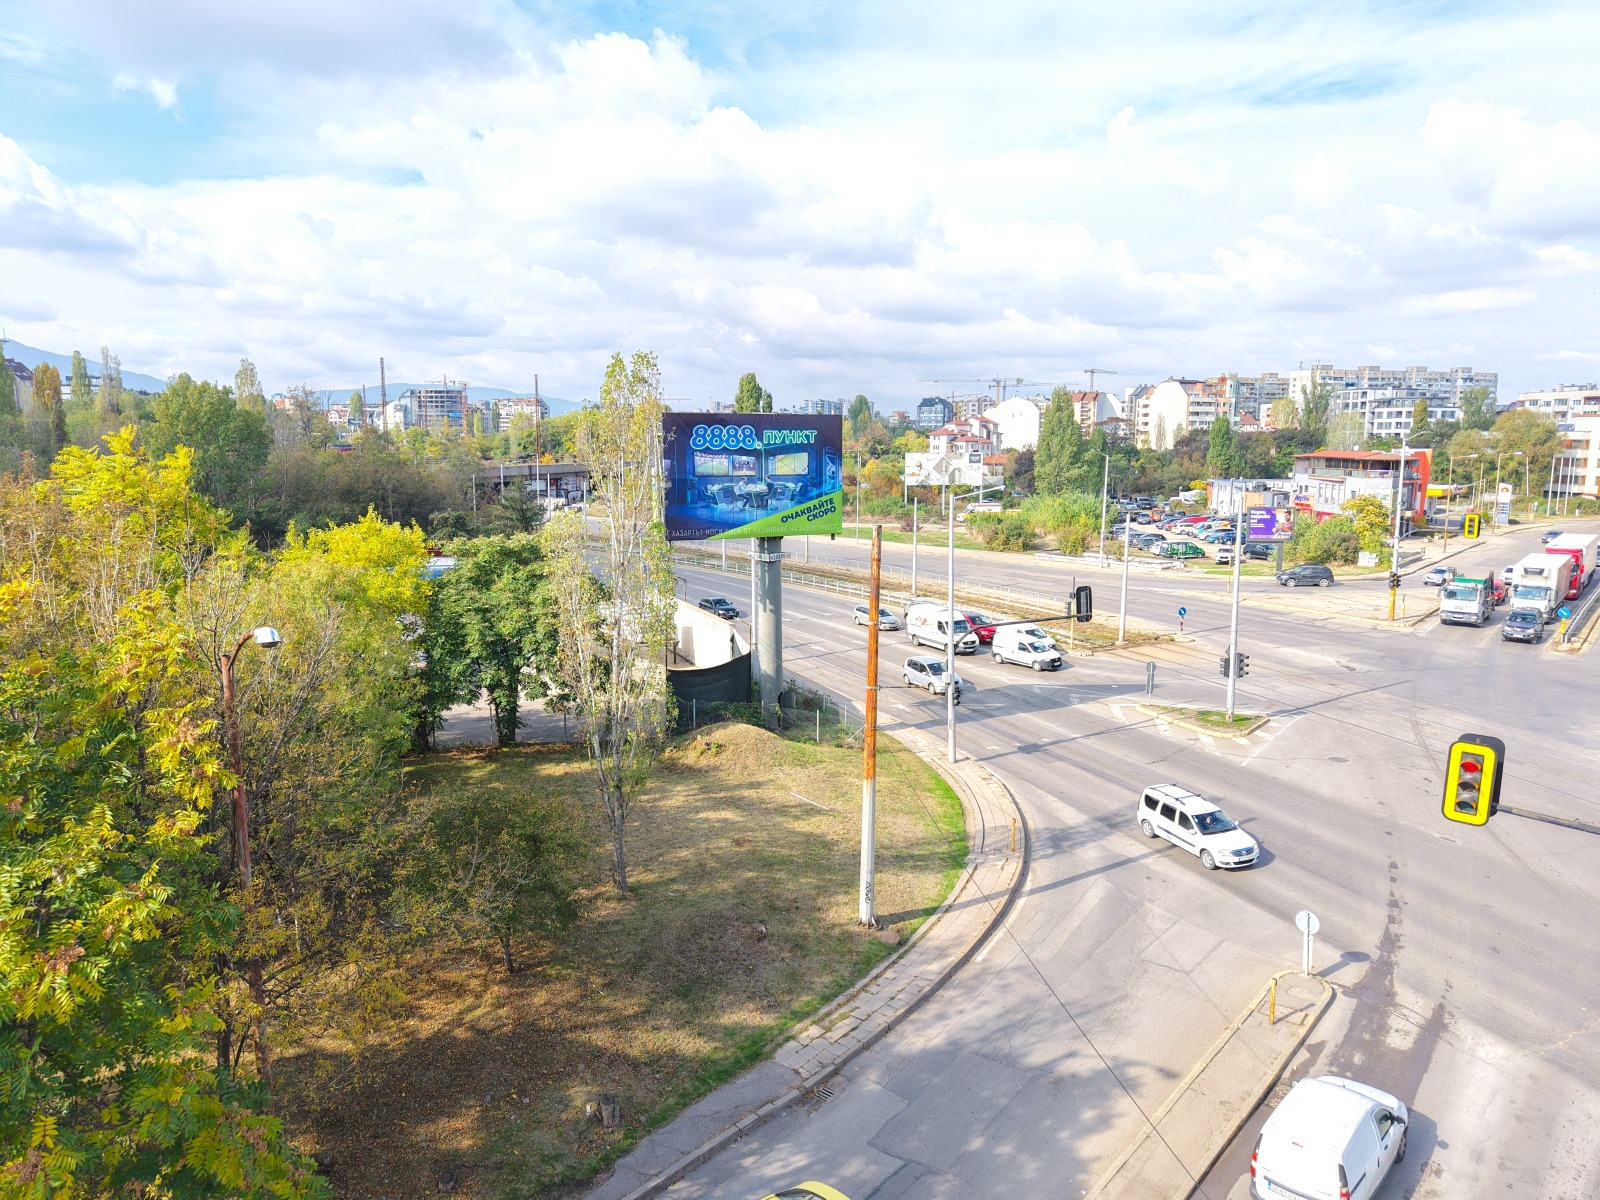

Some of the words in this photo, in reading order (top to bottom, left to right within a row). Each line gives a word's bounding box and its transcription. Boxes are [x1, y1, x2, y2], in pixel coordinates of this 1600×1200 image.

[763, 430, 817, 444] ПУНКТ
[781, 498, 834, 523] ОЧАКВАЙТЕ
[806, 506, 836, 522] СКОРО
[705, 528, 723, 536] НОСИ
